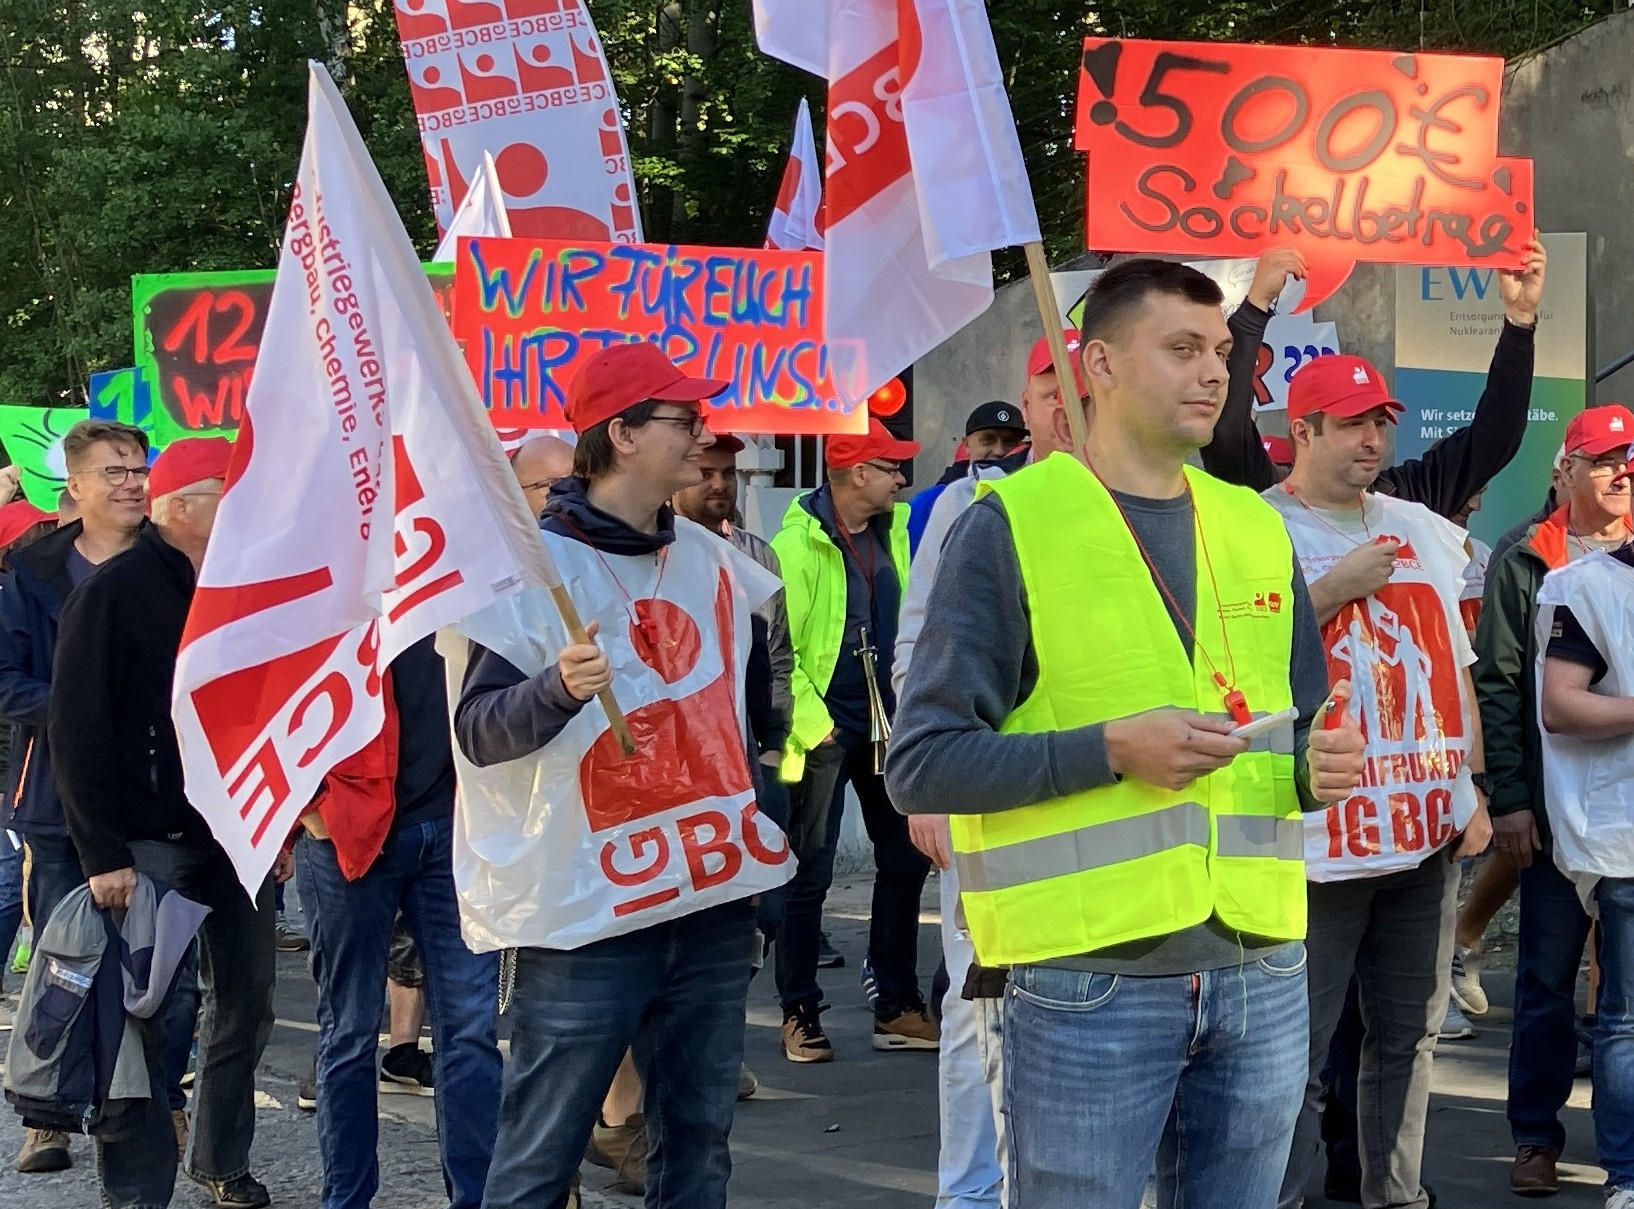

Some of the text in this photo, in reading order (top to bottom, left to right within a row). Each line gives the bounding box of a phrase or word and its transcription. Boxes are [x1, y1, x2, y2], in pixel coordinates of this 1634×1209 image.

[468, 239, 606, 320] WIR
[702, 255, 813, 329] EUCH
[1422, 266, 1504, 301] EW
[1450, 327, 1503, 336] Nuklearan
[172, 367, 254, 430] WI
[1420, 409, 1559, 422] Wir setze täbe.
[1420, 426, 1443, 439] Mit
[1326, 788, 1457, 858] IG BC
[599, 802, 790, 917] IGBC
